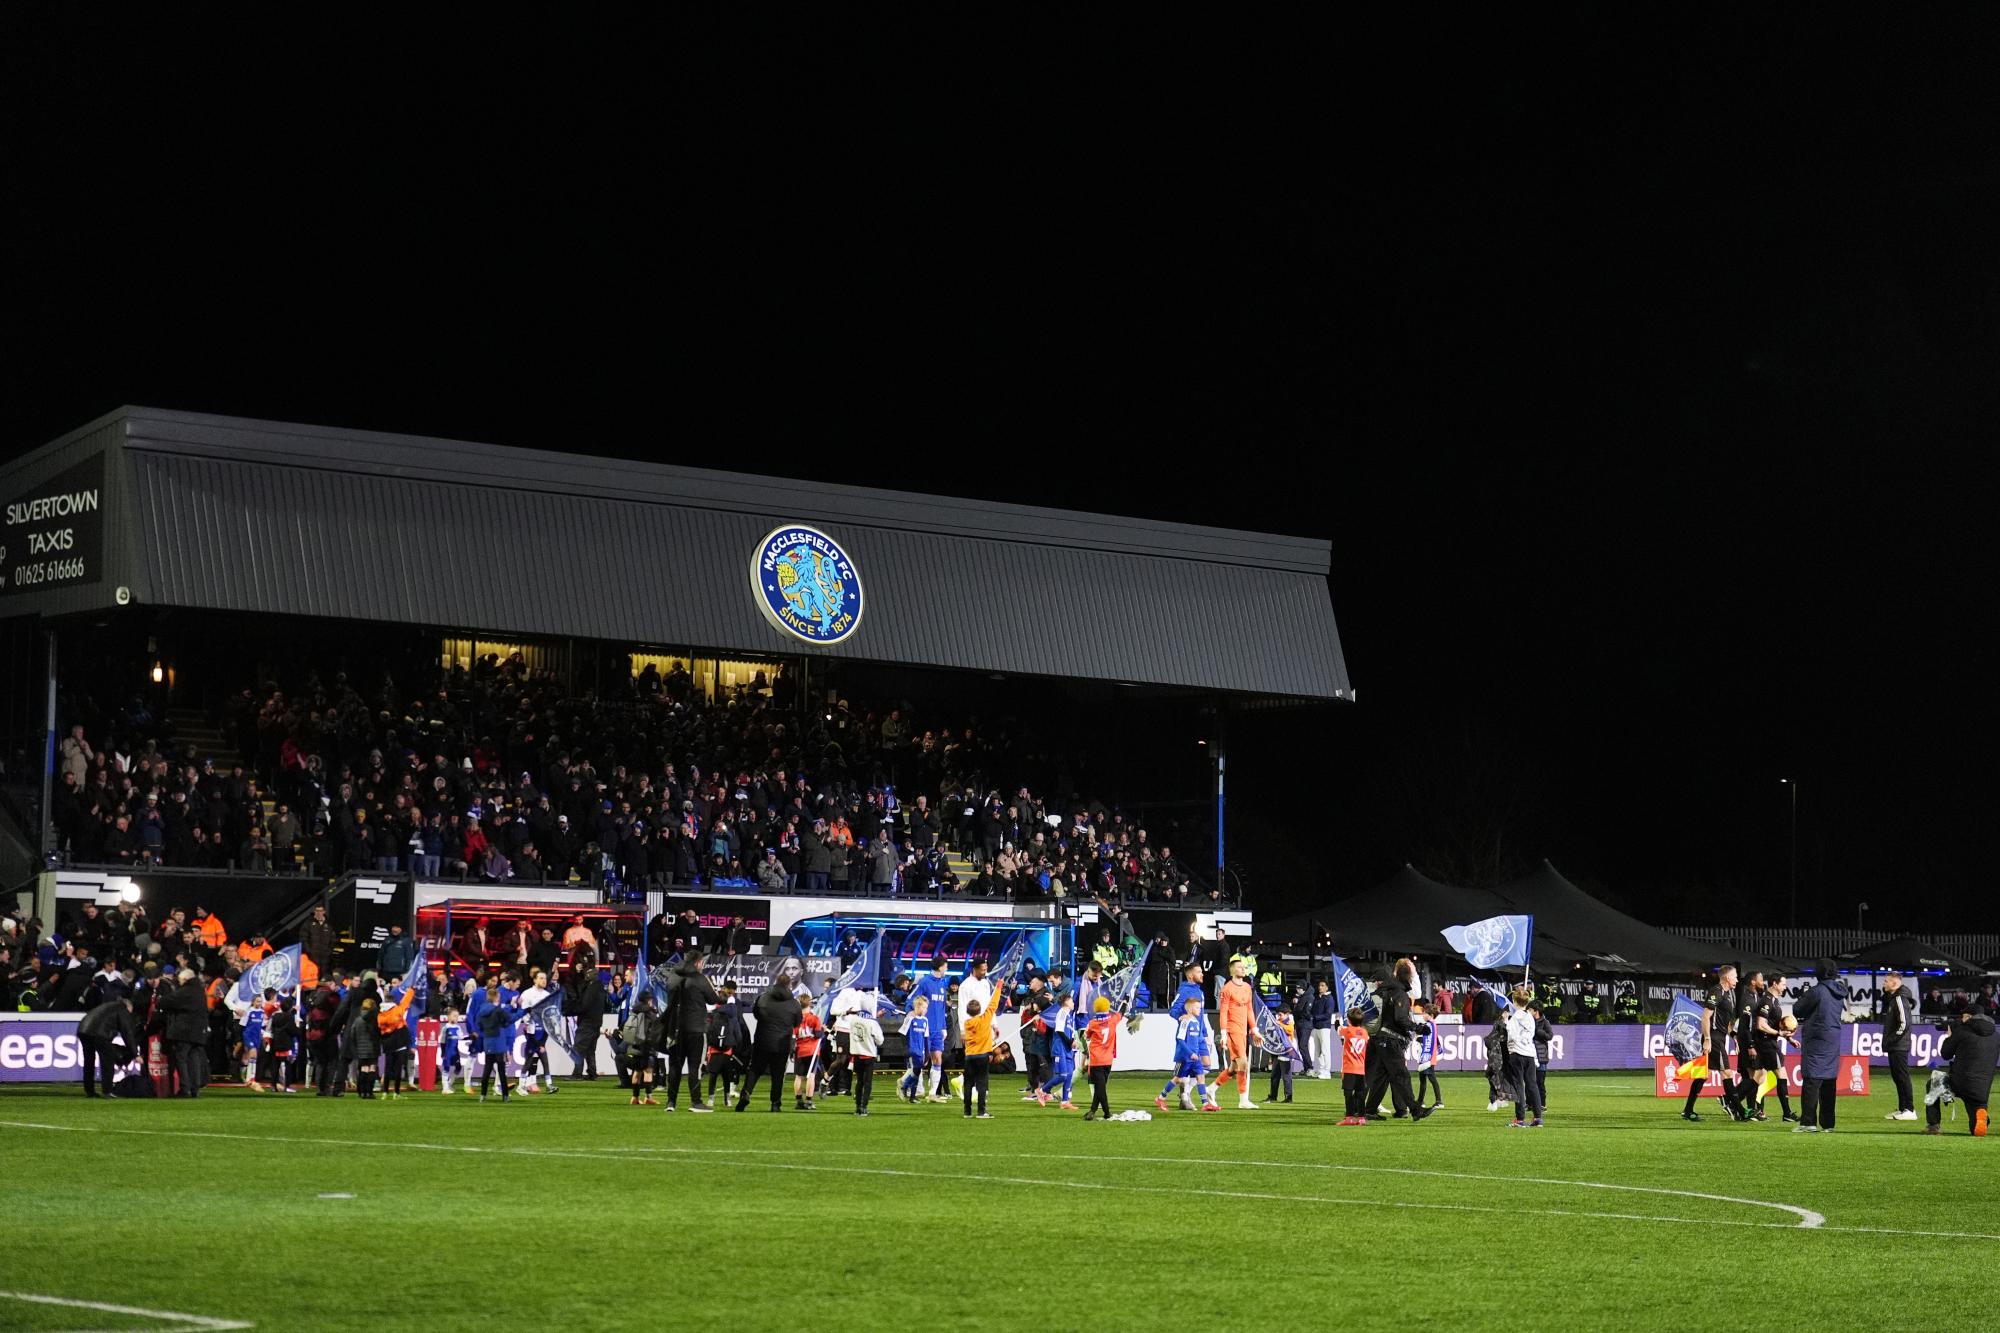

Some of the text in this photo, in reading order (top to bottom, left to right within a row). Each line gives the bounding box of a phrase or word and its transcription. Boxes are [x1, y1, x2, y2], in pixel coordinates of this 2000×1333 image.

[6, 489, 98, 525] SILVERTOWN
[28, 528, 74, 554] TAXIS
[763, 532, 853, 580] MACCLESFIELD FC
[15, 562, 45, 586] 01625
[47, 556, 85, 582] 616666
[780, 606, 853, 636] SINCE 1874
[806, 960, 833, 974] #20
[1648, 986, 1670, 1000] KINGS
[1101, 1028, 1110, 1044] 7
